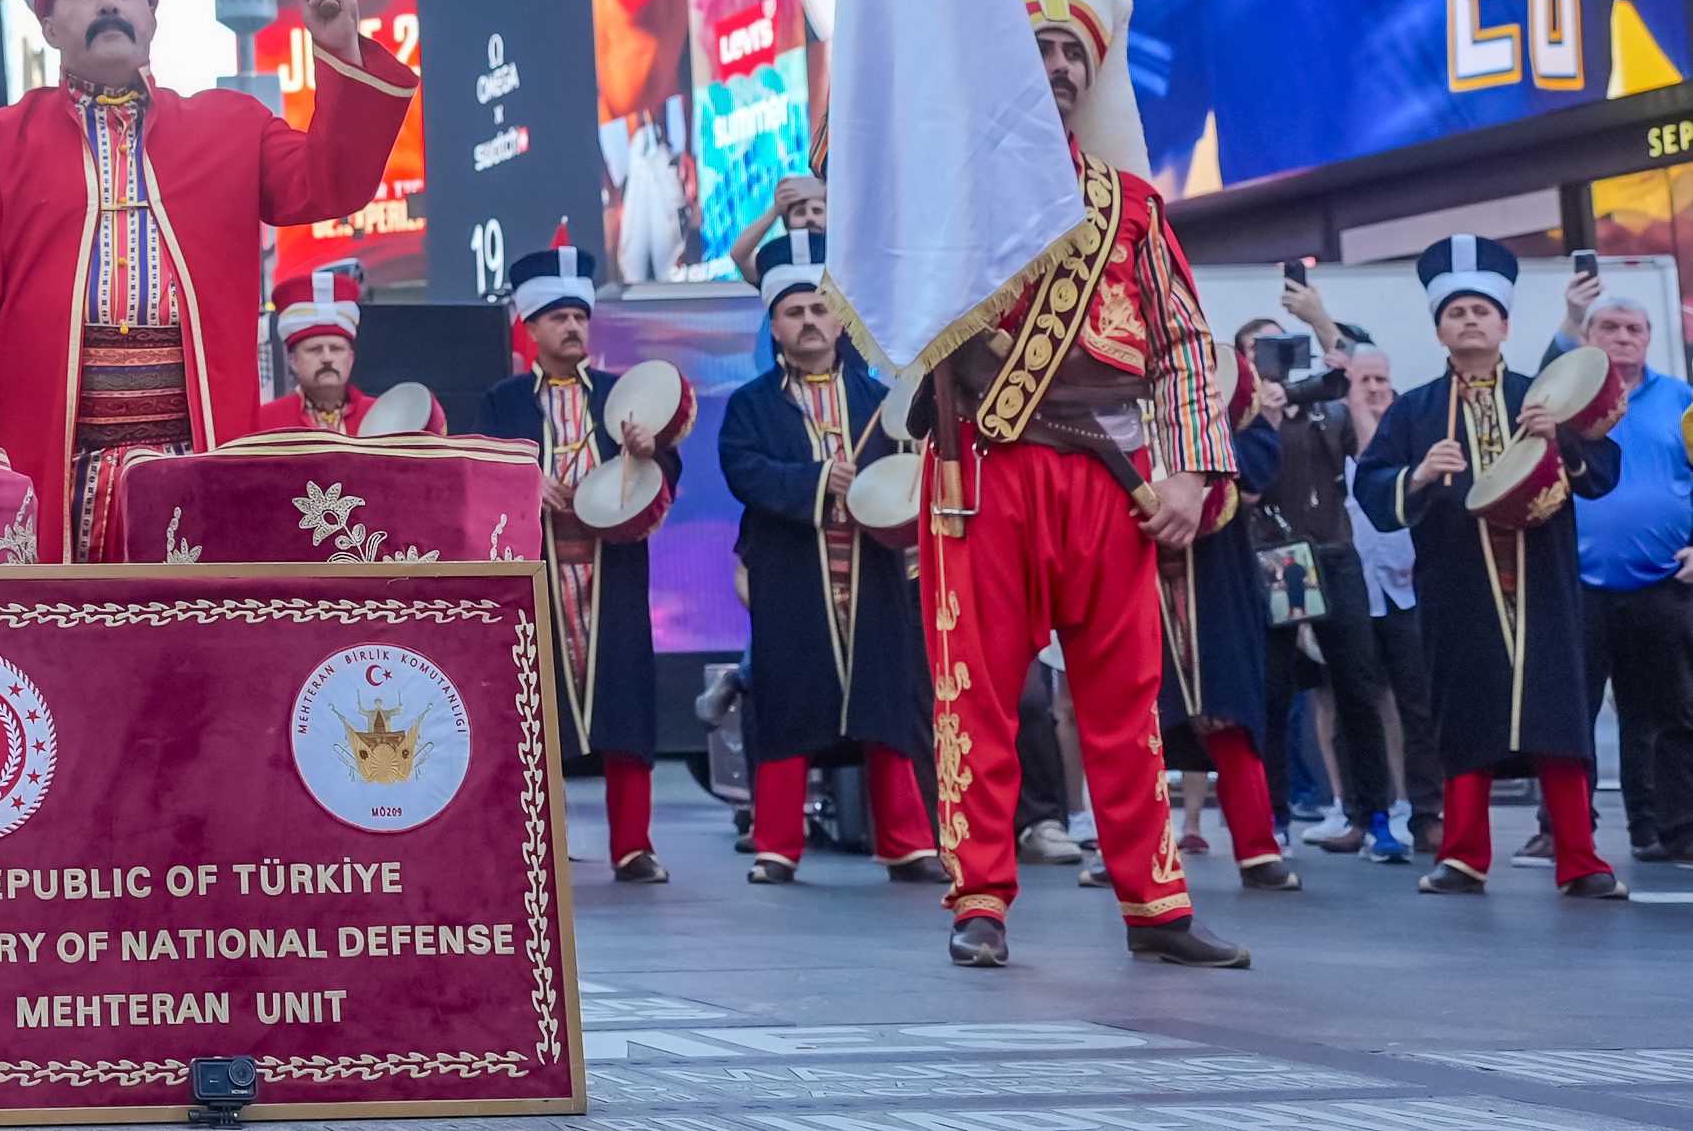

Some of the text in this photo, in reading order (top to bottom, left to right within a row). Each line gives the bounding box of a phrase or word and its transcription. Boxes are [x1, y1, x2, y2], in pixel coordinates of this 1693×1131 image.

[297, 663, 336, 735] MEHTERAN
[166, 864, 218, 897] OF
[232, 856, 403, 896] TÜRKİYE
[56, 931, 109, 963] OF
[121, 928, 328, 961] NATIONAL
[338, 923, 515, 958] DEFENSE
[16, 989, 347, 1028] MEHTERAN UNIT
[656, 1057, 1292, 1084] MAJESTIC
